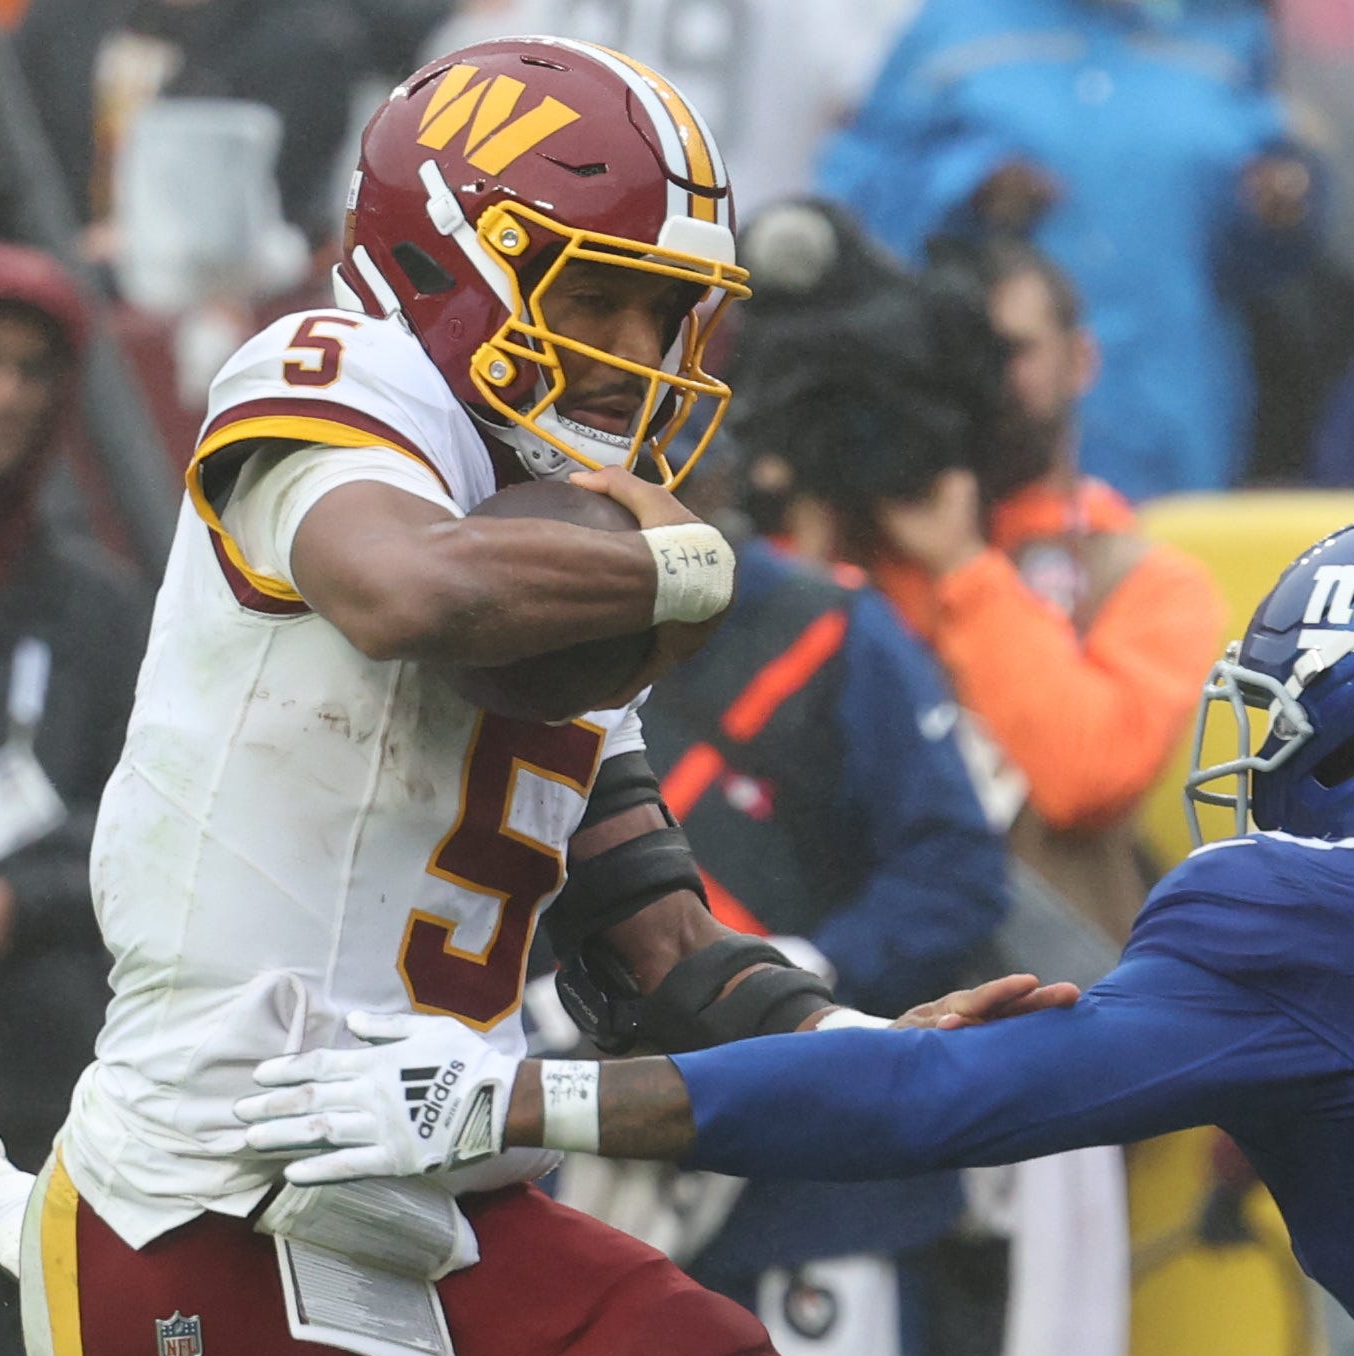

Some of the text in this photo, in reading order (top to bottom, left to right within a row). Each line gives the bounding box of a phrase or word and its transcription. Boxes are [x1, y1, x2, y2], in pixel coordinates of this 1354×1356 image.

[282, 315, 364, 389] 5
[397, 707, 608, 1033] 5
[418, 1059, 465, 1140] adidas
